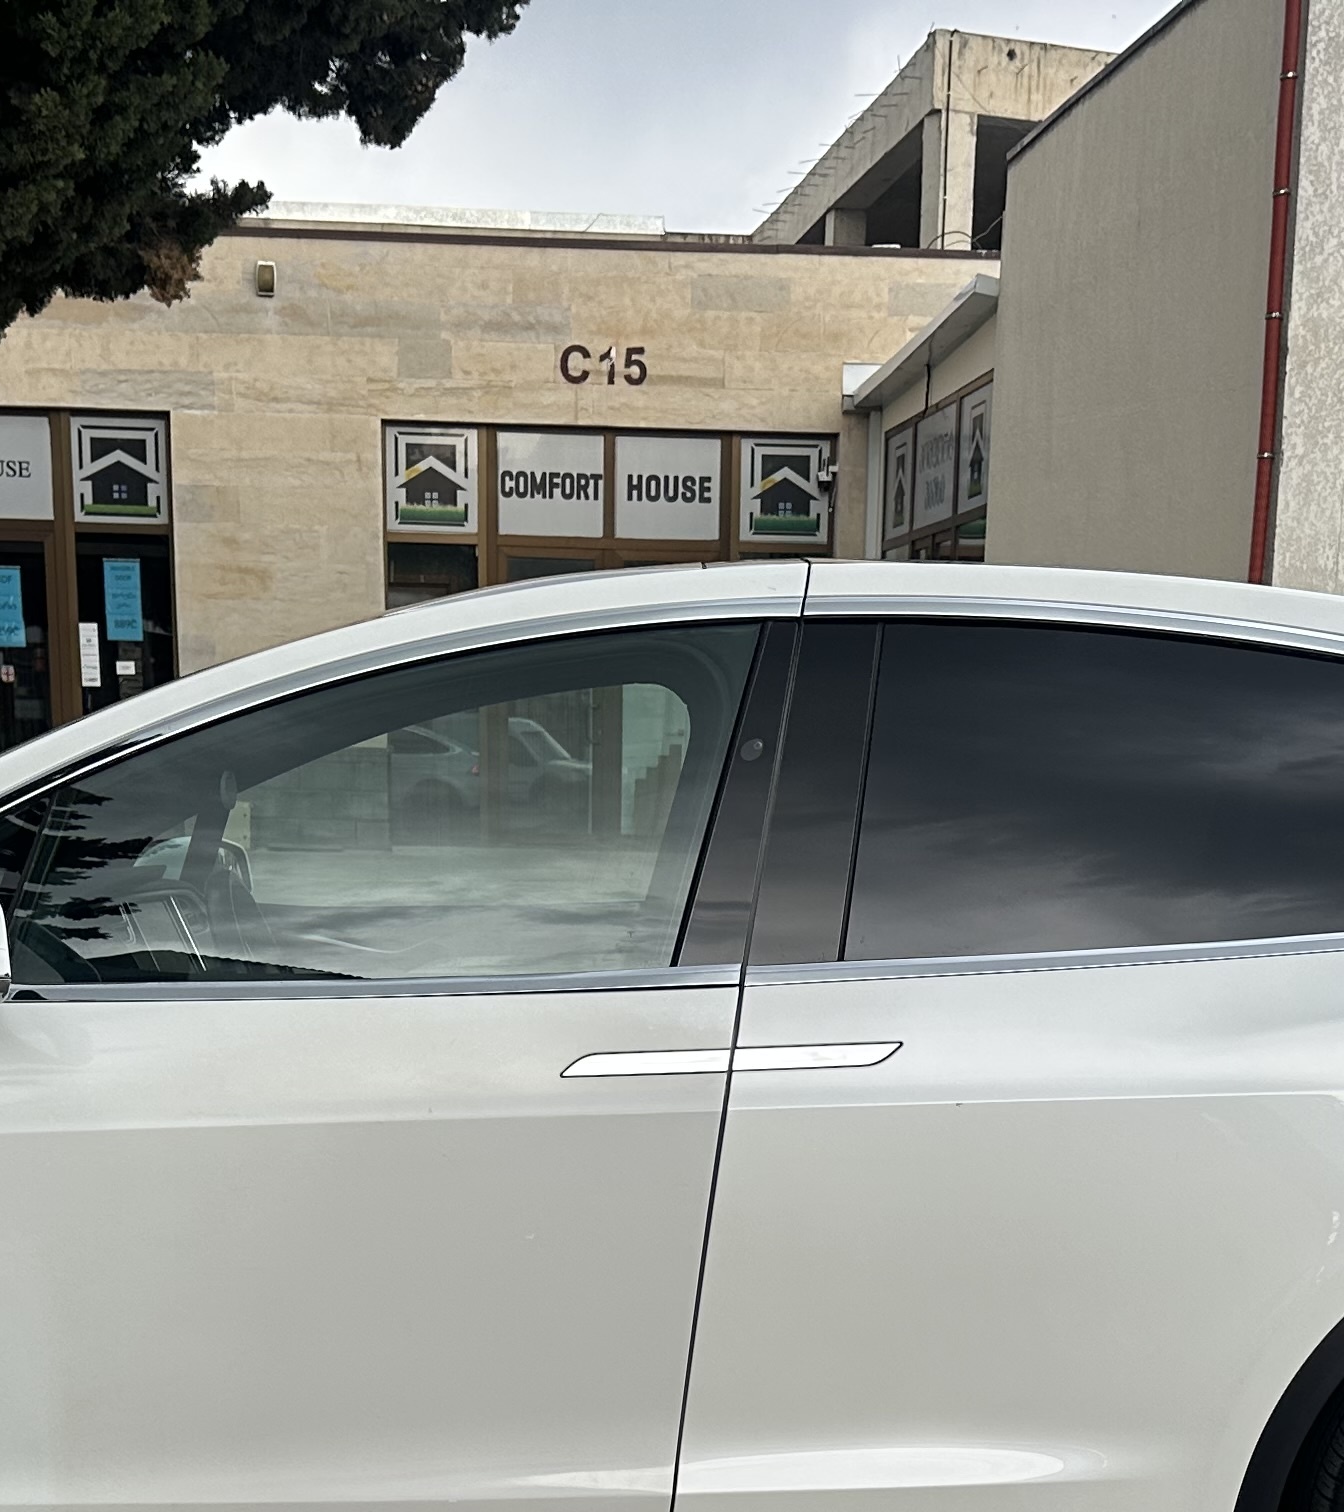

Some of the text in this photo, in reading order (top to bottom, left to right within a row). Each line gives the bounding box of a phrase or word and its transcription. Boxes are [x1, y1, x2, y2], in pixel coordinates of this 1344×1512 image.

[560, 344, 648, 386] C15
[500, 470, 712, 504] COMFORT HOUSE
